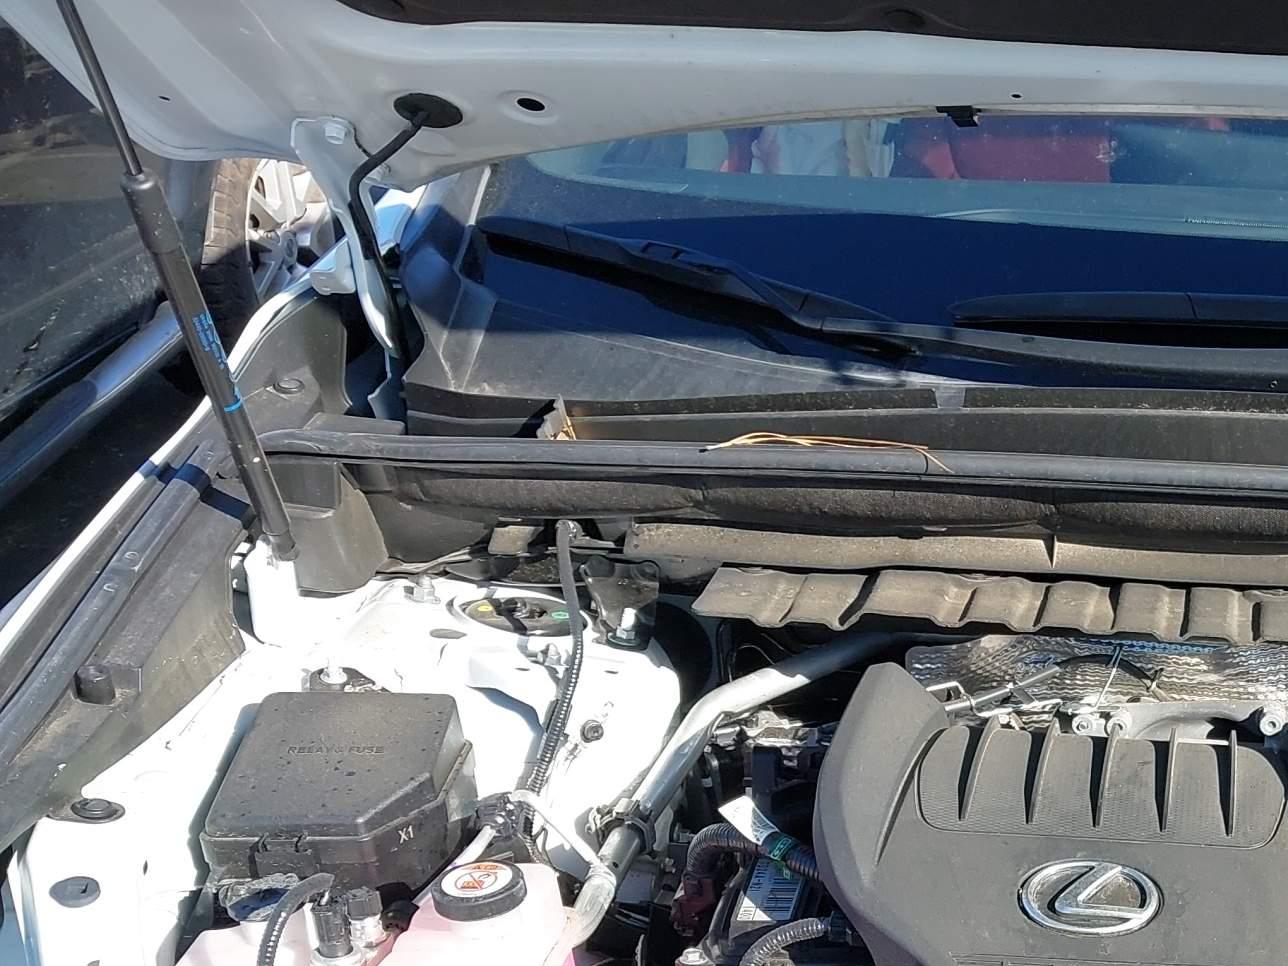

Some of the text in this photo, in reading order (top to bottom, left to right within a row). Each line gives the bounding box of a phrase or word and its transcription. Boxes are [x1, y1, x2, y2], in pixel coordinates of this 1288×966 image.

[287, 745, 330, 755] RELAY
[348, 745, 385, 755] FUSE
[398, 825, 414, 844] X1
